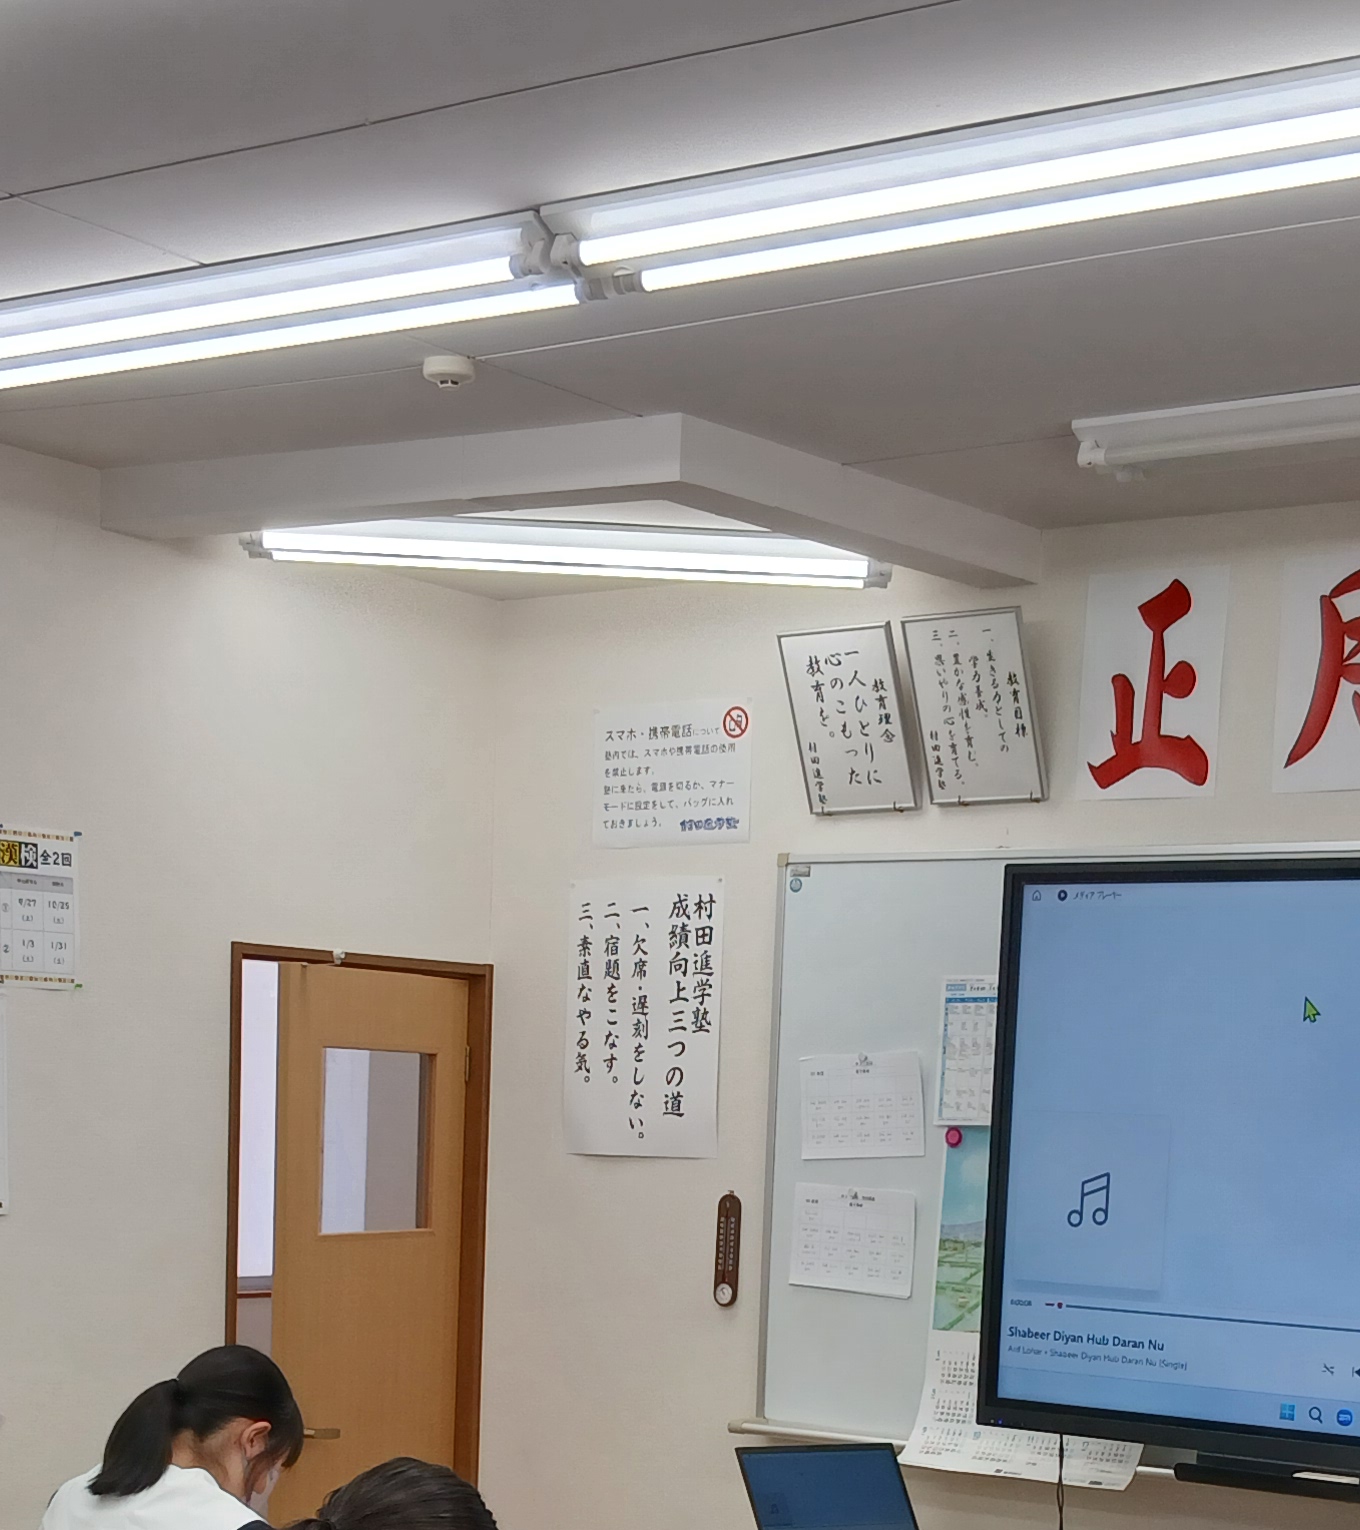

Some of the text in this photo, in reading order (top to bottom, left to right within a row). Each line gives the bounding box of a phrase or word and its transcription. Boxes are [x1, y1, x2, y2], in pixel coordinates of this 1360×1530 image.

[605, 724, 720, 742] スマホ・携帯電話について
[825, 653, 862, 785] 心のこもった
[0, 841, 72, 868] 漢検 全2回
[574, 903, 594, 1083] 三、素直なやる気。
[603, 903, 620, 1084] 二、宿題をこなす。
[662, 893, 692, 1118] 成績向上三つの道
[691, 893, 716, 1034] 村田進学塾
[1007, 1326, 1165, 1351] Shabeer Diyan Hub Daran Nu
[1121, 1355, 1143, 1365] Daran
[1146, 1357, 1157, 1366] Nu
